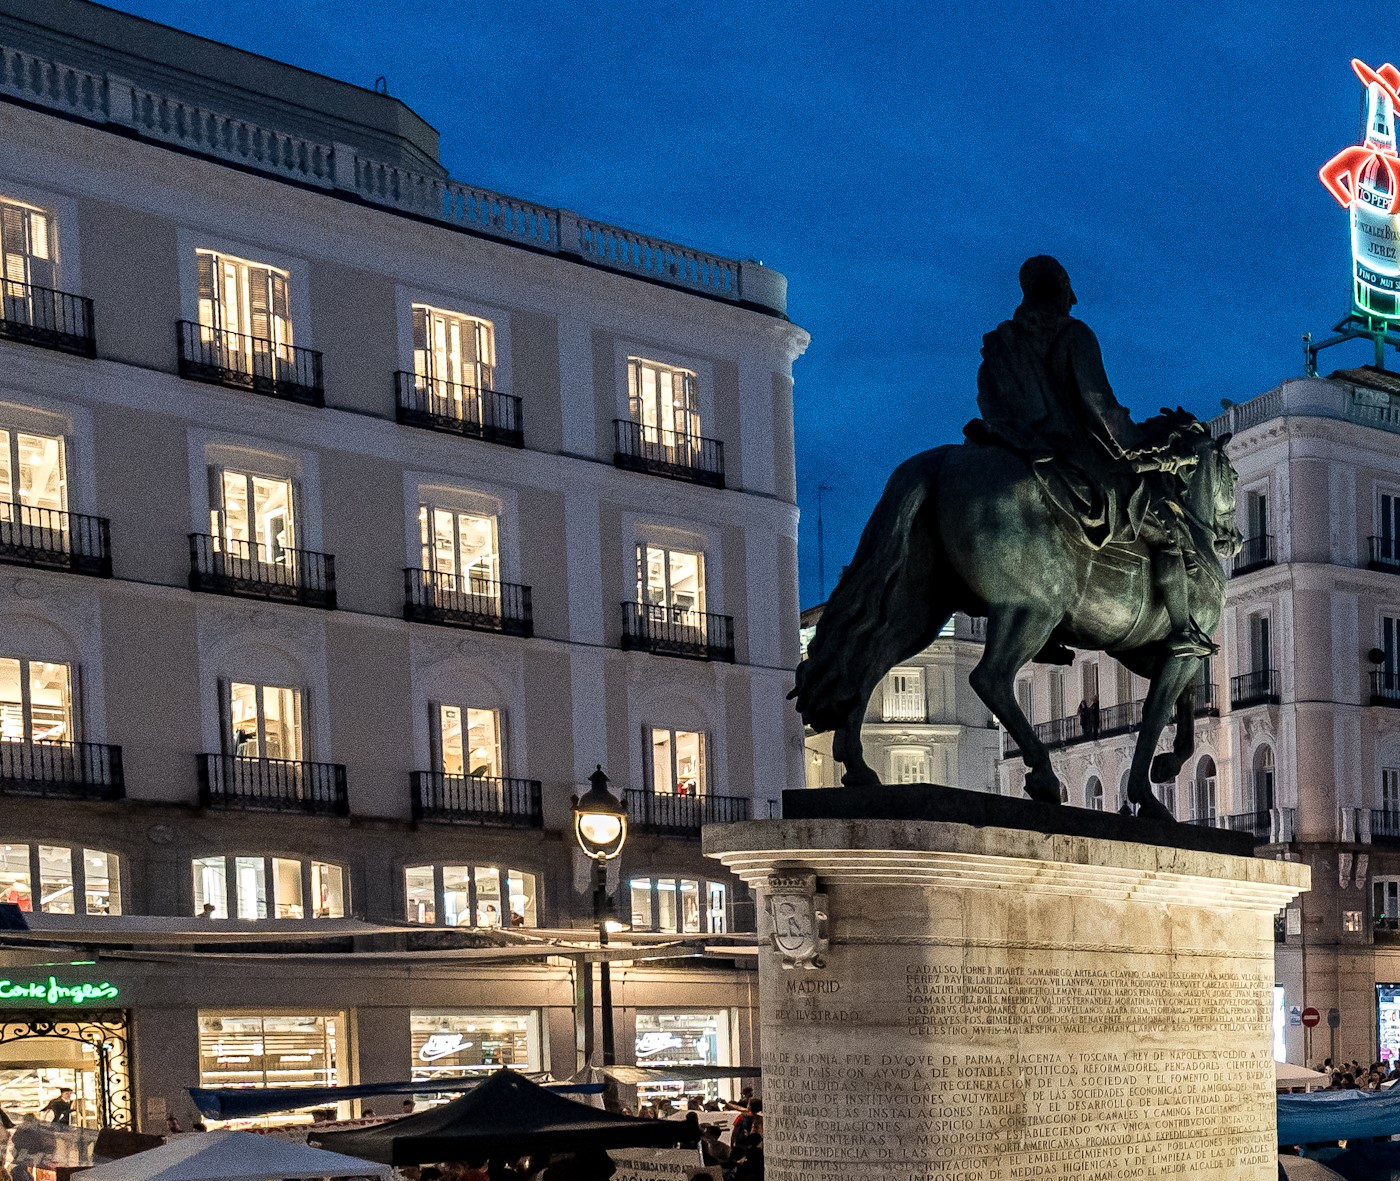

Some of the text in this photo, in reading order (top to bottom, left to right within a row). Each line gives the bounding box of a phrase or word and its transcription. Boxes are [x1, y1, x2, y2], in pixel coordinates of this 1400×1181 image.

[1368, 243, 1397, 259] JEREZ
[1359, 269, 1376, 284] FINO
[0, 975, 119, 1005] Corte Inglés
[786, 980, 841, 994] MADRID
[846, 1055, 871, 1065] FVE
[882, 1055, 934, 1066] DVQVE
[943, 1056, 957, 1065] DE
[1010, 1053, 1062, 1063] PIACENZA
[1068, 1053, 1074, 1062] Y
[1080, 1053, 1118, 1062] TOSCANA
[1123, 1052, 1129, 1061] Y
[1133, 1052, 1148, 1060] REY
[1154, 1052, 1164, 1060] DE
[1213, 1050, 1246, 1059] SVCEDIO
[790, 1066, 801, 1076] EL
[838, 1068, 864, 1078] CON
[873, 1068, 922, 1079] AYVDA
[932, 1069, 949, 1079] DE
[958, 1066, 1012, 1077] NOTABLES
[768, 1079, 795, 1089] DICTO
[802, 1080, 857, 1091] MEDIDAS
[867, 1081, 902, 1091] PARA
[914, 1081, 931, 1091] LA
[941, 1079, 1030, 1091] REGENERACION
[1038, 1078, 1052, 1088] DE
[1060, 1078, 1073, 1087] LA
[1081, 1075, 1138, 1087] SOCIEDAD
[1147, 1075, 1151, 1084] Y
[1157, 1075, 1166, 1083] EL
[1171, 1073, 1209, 1083] FOMENTO
[1214, 1073, 1224, 1081] DE
[990, 1170, 1002, 1179] DE
[1010, 1165, 1056, 1177] MEDIDAS
[1063, 1159, 1118, 1172] HIGIENICAS
[1124, 1158, 1129, 1166] Y
[1135, 1157, 1146, 1165] DE
[1152, 1153, 1191, 1163] LIMPIEZA
[1197, 1151, 1206, 1159] DE
[1211, 1149, 1225, 1158] LAS
[1118, 1168, 1143, 1179] COMO
[1148, 1167, 1156, 1176] EL
[1161, 1164, 1186, 1174] MEJOR
[1190, 1161, 1223, 1171] ALCALDE
[1227, 1159, 1235, 1167] DE
[1240, 1156, 1269, 1165] MADRID
